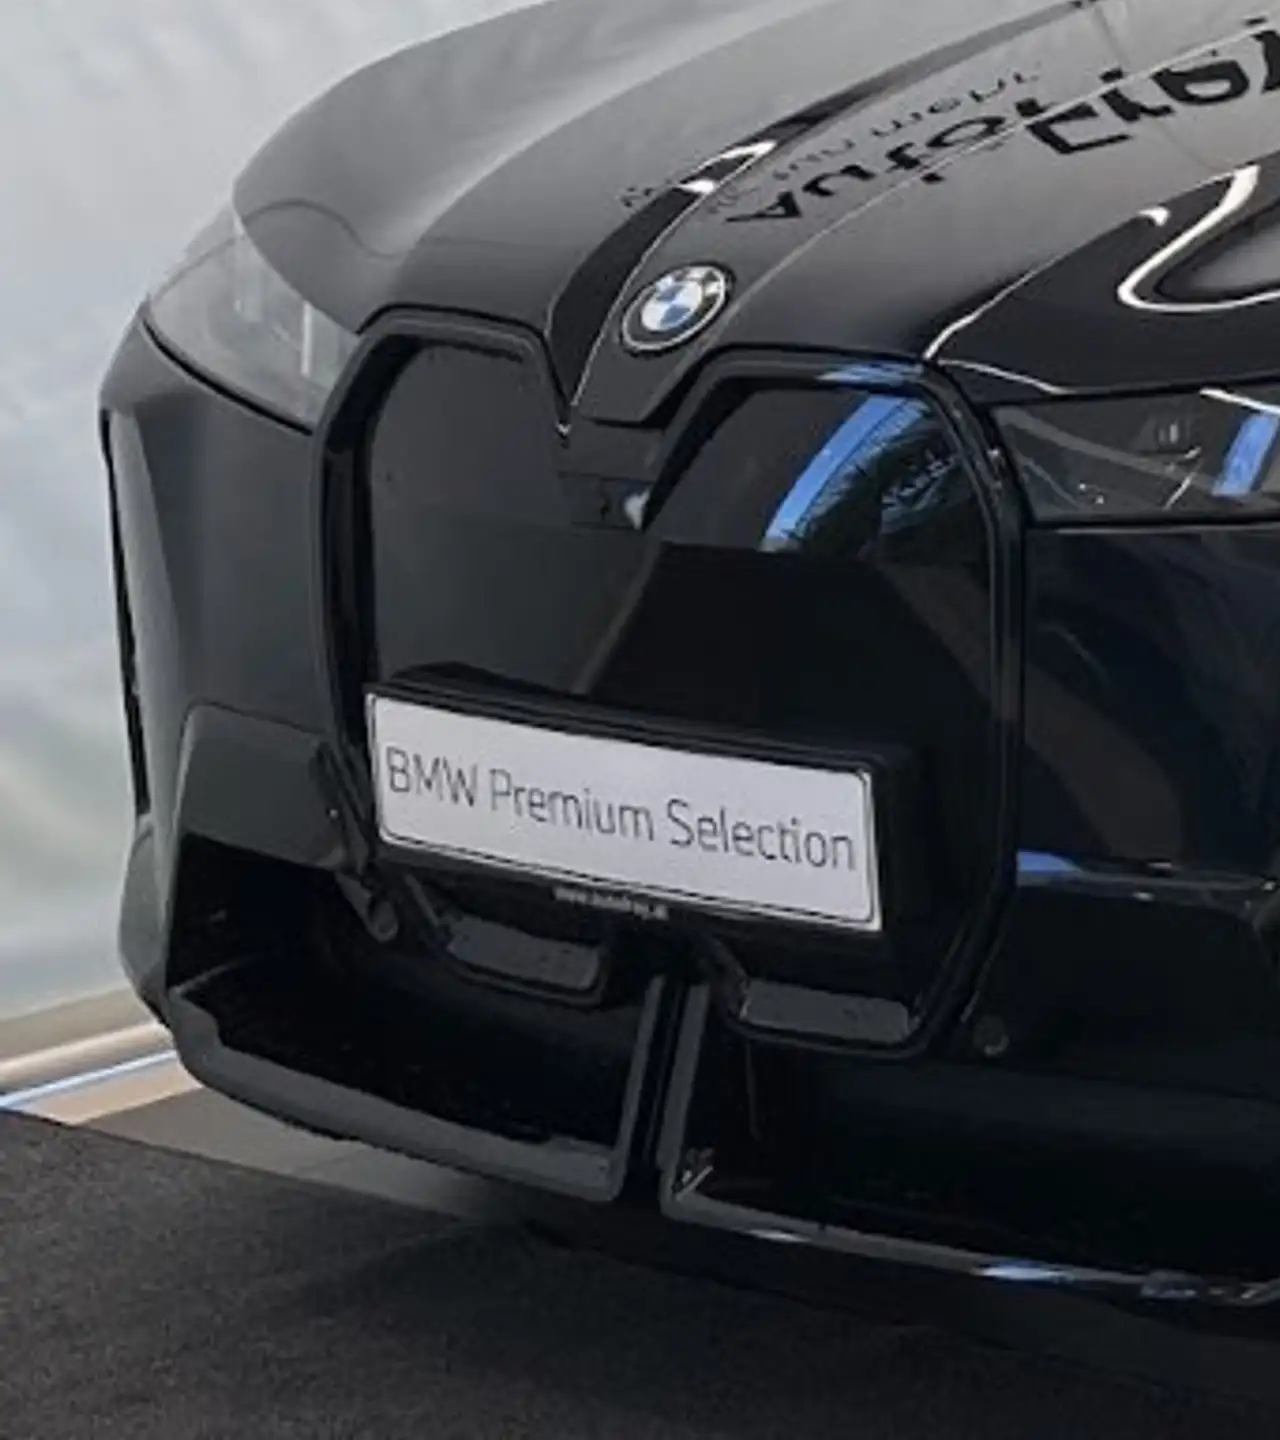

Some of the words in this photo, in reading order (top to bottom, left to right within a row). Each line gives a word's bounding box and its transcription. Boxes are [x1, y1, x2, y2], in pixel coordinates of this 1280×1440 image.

[386, 746, 477, 808] BMW
[489, 767, 656, 843] Premium
[665, 796, 856, 870] Selection
